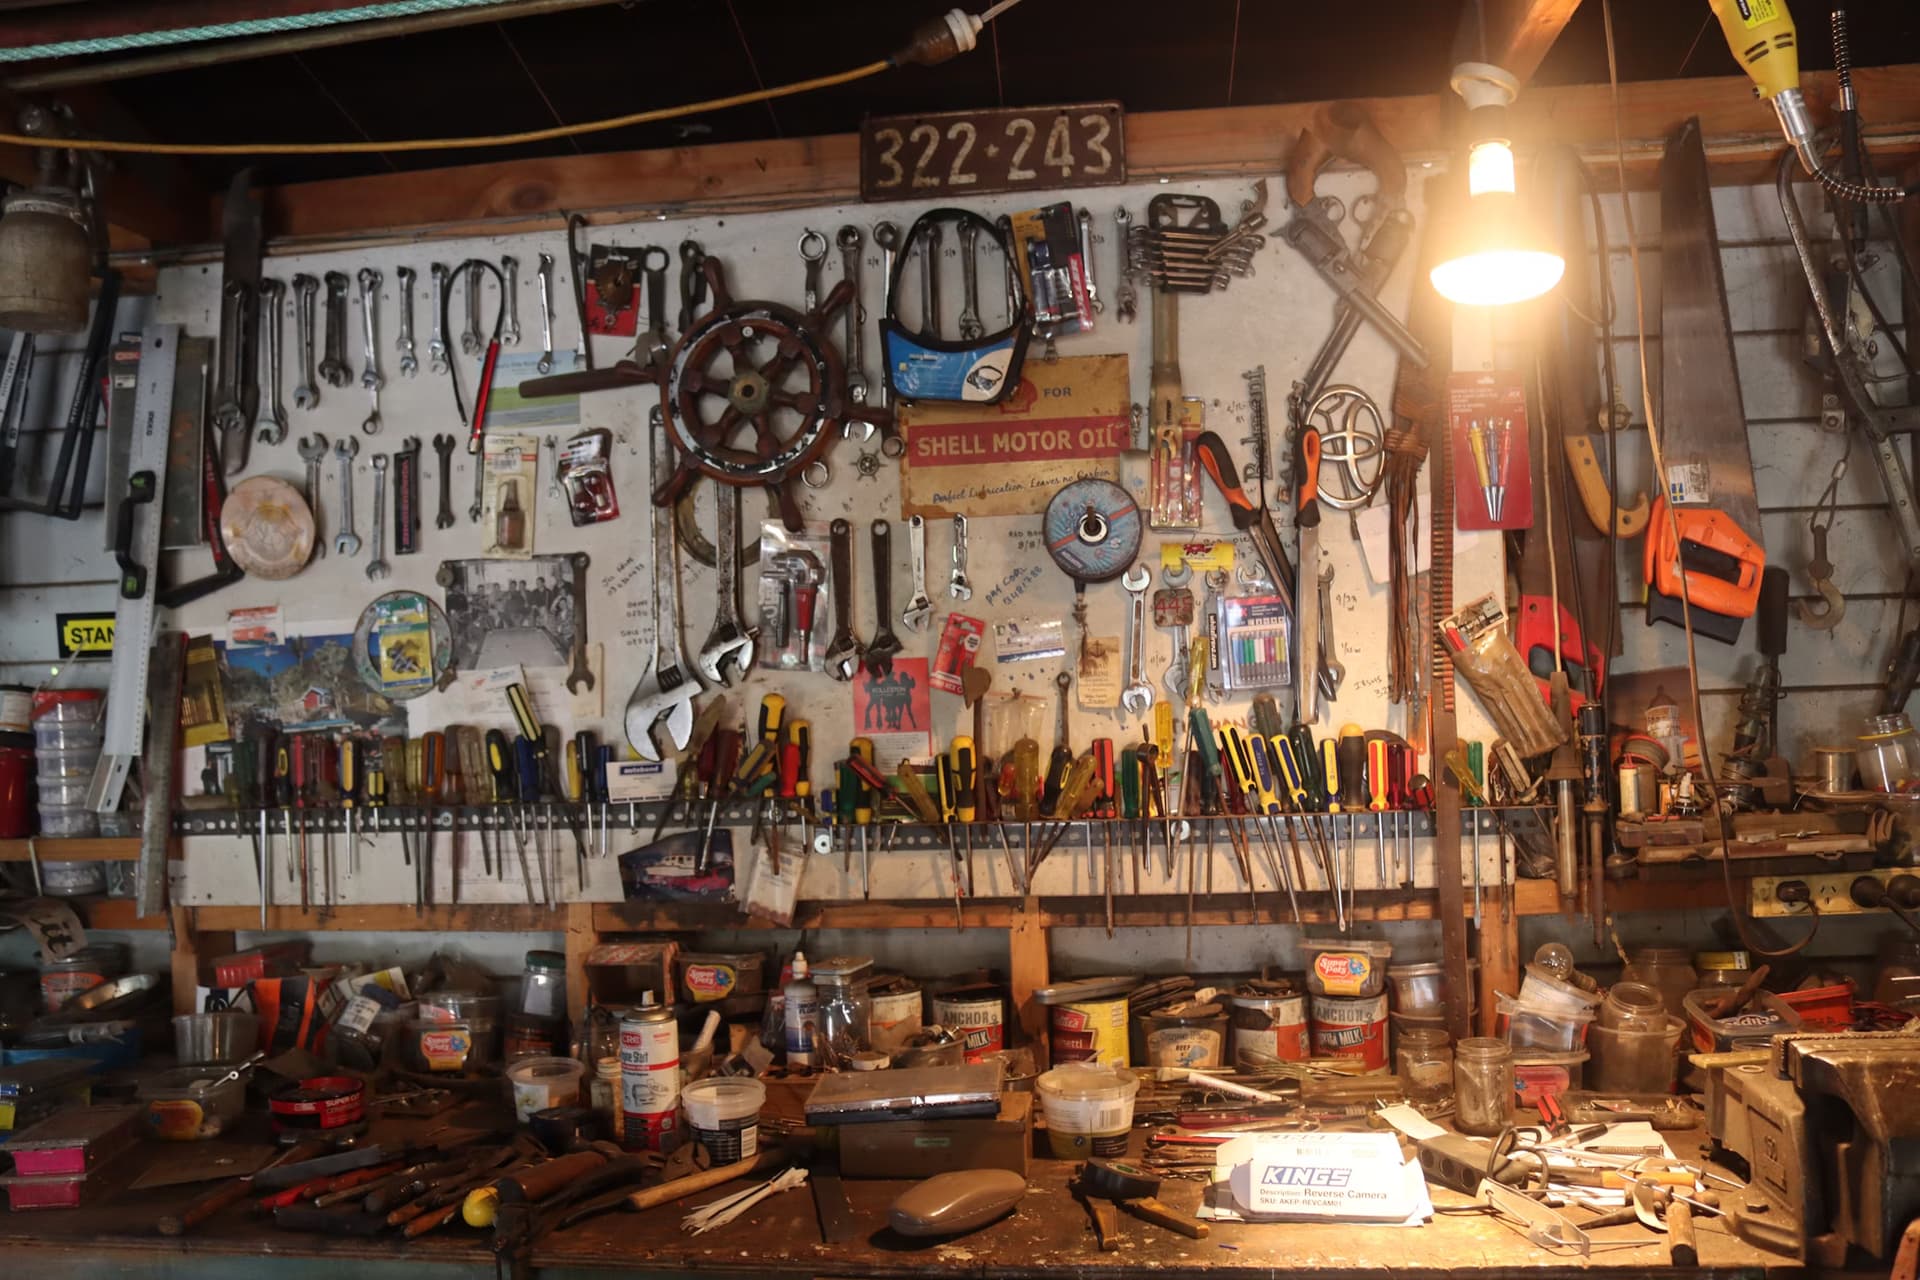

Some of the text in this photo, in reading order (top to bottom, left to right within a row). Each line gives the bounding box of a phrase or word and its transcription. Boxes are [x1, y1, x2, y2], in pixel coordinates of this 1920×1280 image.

[1044, 387, 1072, 397] FOR
[917, 424, 1119, 457] SHELL MOTOR OIL
[932, 488, 967, 504] Perfect
[968, 482, 1024, 499] Lubrication
[1320, 956, 1348, 968] Super
[943, 1008, 989, 1024] ANCHOR
[967, 1031, 988, 1048] MILK
[1340, 1029, 1361, 1046] MILK
[1261, 1165, 1352, 1187] KINGS
[1304, 1188, 1345, 1199] Reverse
[1347, 1189, 1387, 1200] Camera
